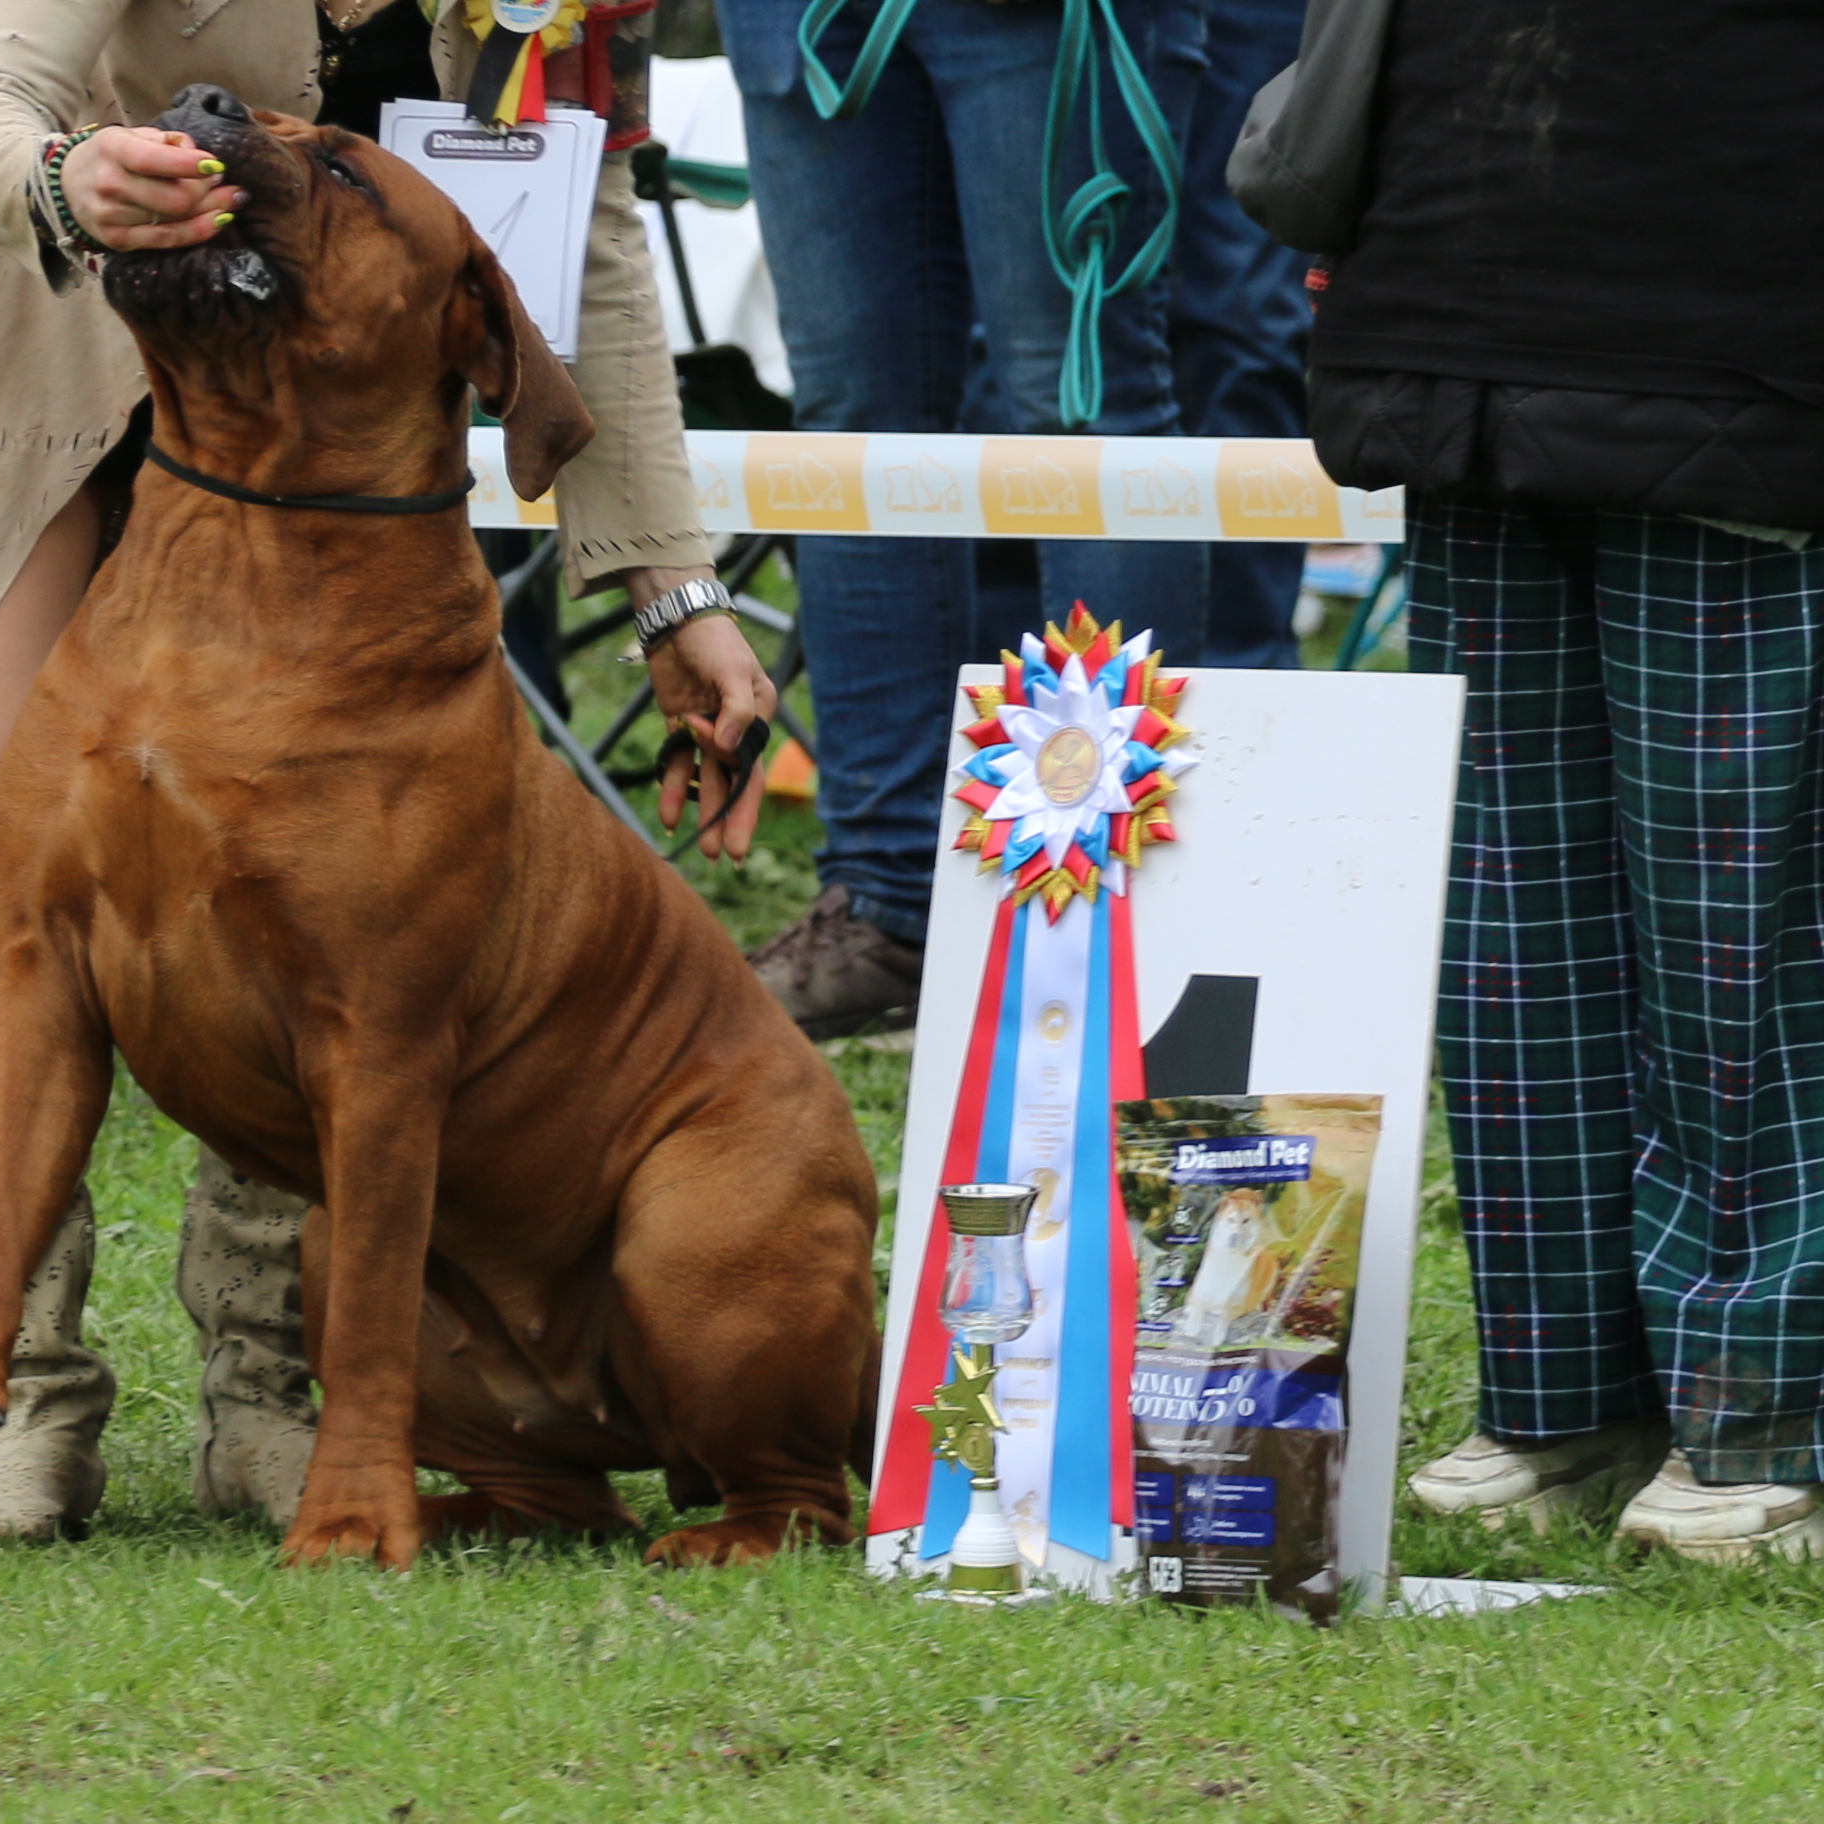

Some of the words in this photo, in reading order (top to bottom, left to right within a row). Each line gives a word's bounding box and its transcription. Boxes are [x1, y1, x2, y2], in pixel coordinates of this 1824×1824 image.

[432, 133, 506, 151] Diamond
[507, 136, 537, 152] Pet
[1176, 1142, 1268, 1170] Diamond
[1269, 1140, 1312, 1167] Pet
[1130, 1371, 1197, 1398] NIMAL
